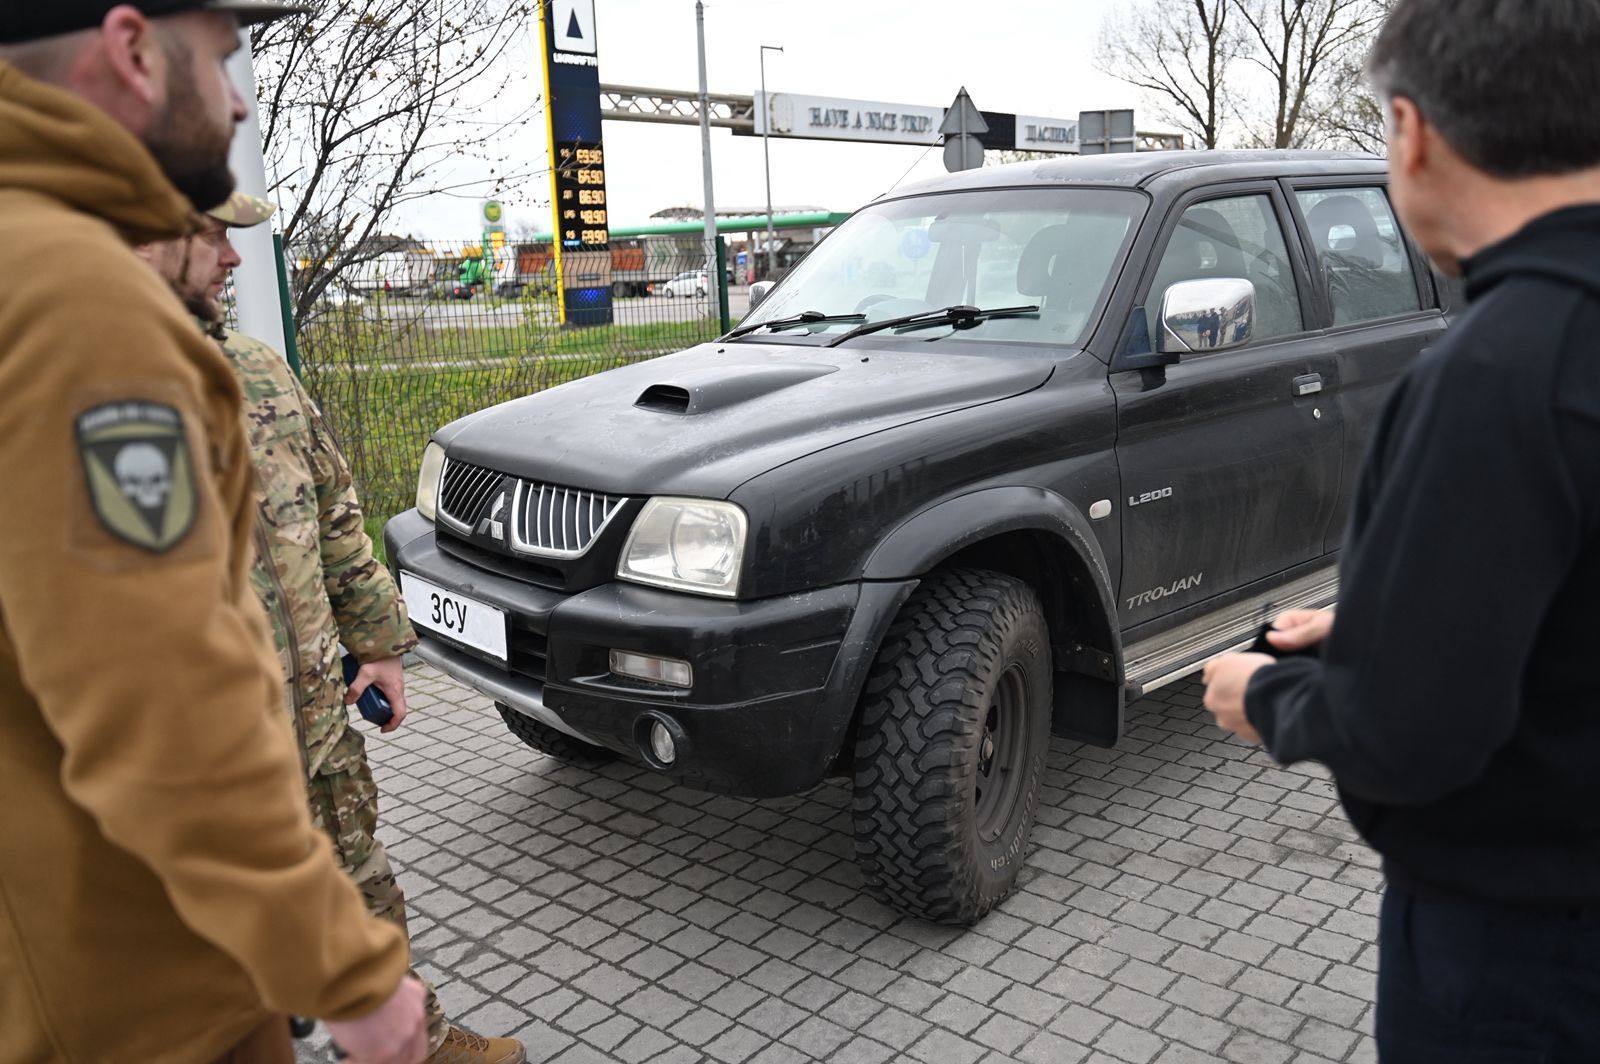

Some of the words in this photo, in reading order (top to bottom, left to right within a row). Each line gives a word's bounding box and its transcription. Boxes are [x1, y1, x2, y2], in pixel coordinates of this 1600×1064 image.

[809, 107, 849, 129] HAVE
[852, 110, 863, 130] A
[865, 111, 897, 132] NICE
[900, 114, 933, 134] TRIP!
[1128, 486, 1173, 507] L200
[1126, 572, 1203, 610] TROJAN
[430, 592, 467, 634] ЗСУ
